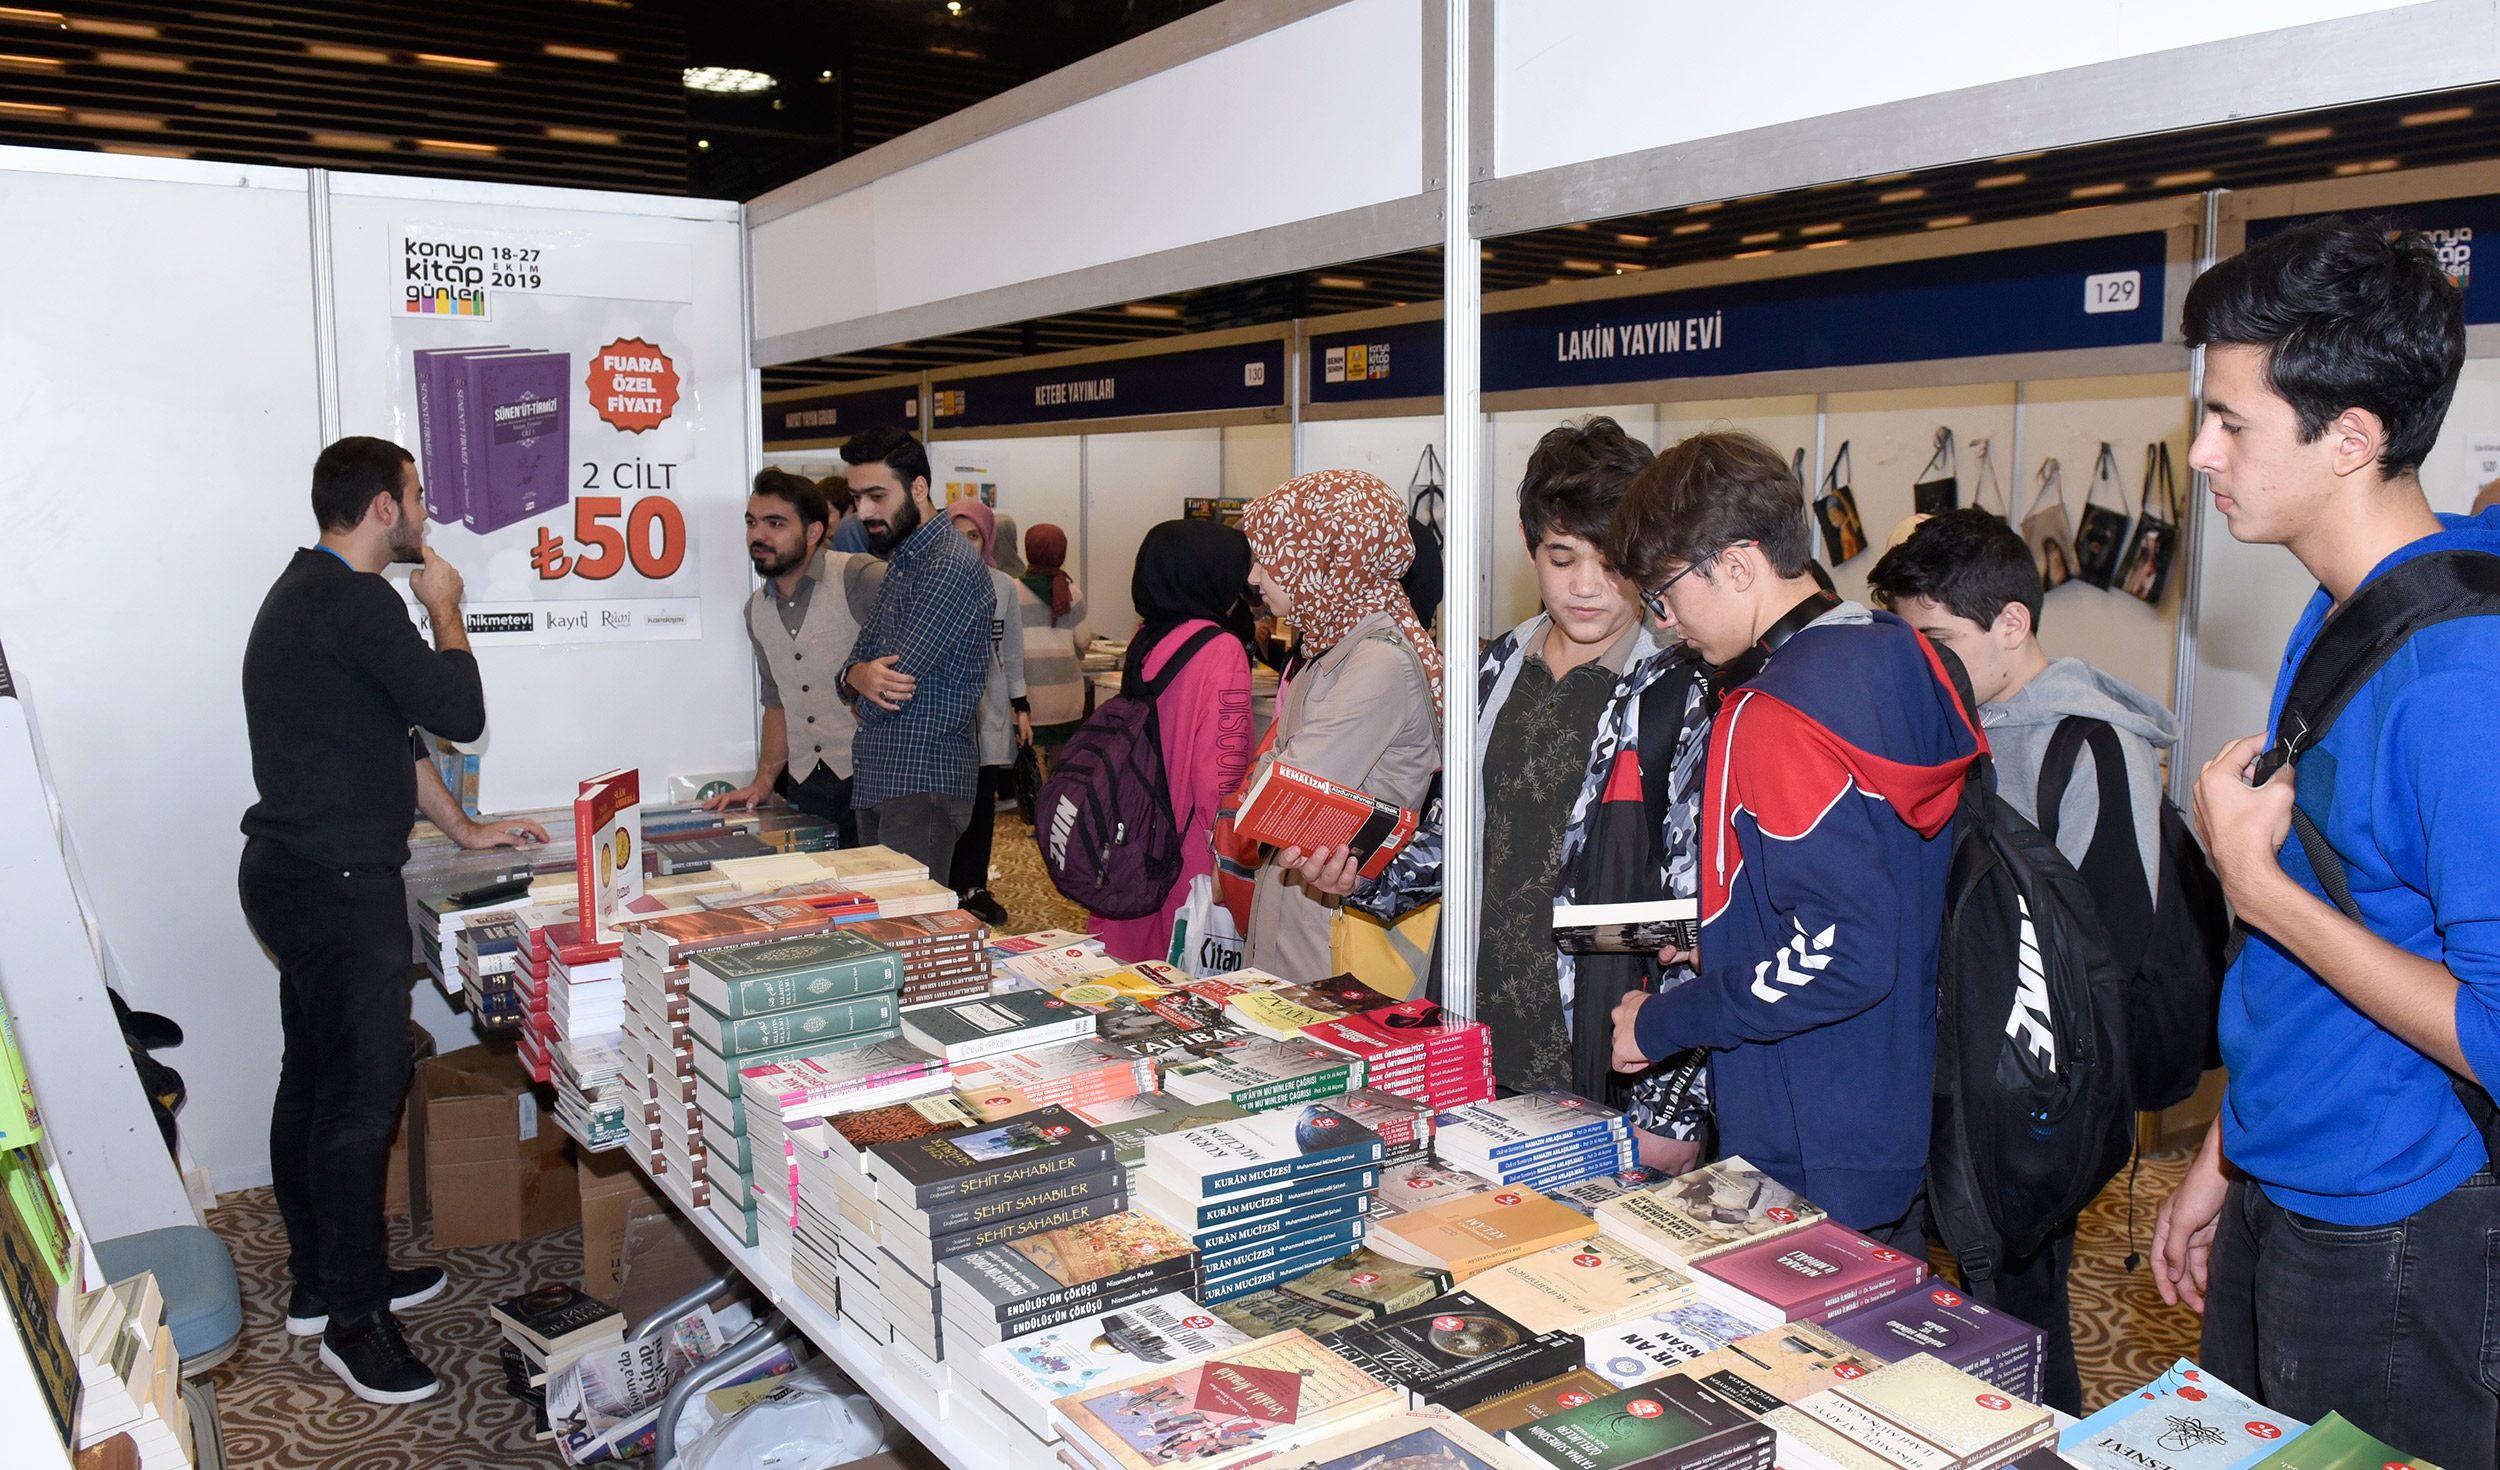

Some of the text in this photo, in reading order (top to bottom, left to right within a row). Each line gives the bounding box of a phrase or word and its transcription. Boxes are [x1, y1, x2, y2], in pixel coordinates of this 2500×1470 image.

[405, 237, 483, 263] konya
[491, 247, 540, 262] 18-27
[405, 258, 483, 286] kitap
[491, 273, 541, 288] 2019
[406, 284, 484, 302] günleri
[2096, 280, 2134, 304] 129
[1558, 309, 1722, 362] LAKİN YAYIN EVİ
[604, 355, 664, 373] FUARA
[1248, 368, 1262, 382] 130
[612, 375, 656, 393] ÖZEL
[1036, 378, 1115, 406] KETEBE YAYINLARI
[608, 395, 662, 413] FİYAT!
[582, 457, 677, 489] 2 CİLT
[467, 613, 533, 626] hikmetevi
[1049, 794, 1079, 872] NIKE
[1296, 1076, 1317, 1089] ÇAĞRISI
[960, 1172, 1001, 1195] ŞEHİT
[1003, 1156, 1076, 1182] SAHABİLER
[1214, 1172, 1247, 1189] KURÂN
[1248, 1163, 1292, 1182] MUCİZESİ
[974, 1199, 1013, 1222] ŞEHİT
[1015, 1182, 1089, 1209] SAHABİLER
[1206, 1204, 1239, 1221] KURÂN
[1241, 1193, 1283, 1213] MUCİZESİ
[976, 1224, 1015, 1247] ŞEHİT
[1017, 1206, 1090, 1235] SAHABİLER
[1205, 1231, 1237, 1248] KURÂN
[1239, 1220, 1280, 1241] MUCİZESİ
[1206, 1257, 1232, 1274] URÂN
[1233, 1245, 1275, 1266] MUCİZESİ
[1777, 1255, 1822, 1278] NAFAKA
[1234, 1271, 1275, 1291] MUCİZESİ
[1007, 1288, 1062, 1317] ENDÜLÜS'ÜN
[1063, 1282, 1098, 1304] ÇÖKÜŞÜ
[1013, 1306, 1068, 1334] ENDÜLÜS'ÜN
[1069, 1299, 1103, 1322] ÇÖKÜŞÜ
[1620, 1333, 1683, 1369] UR'AN
[1655, 1332, 1705, 1359] NSAN
